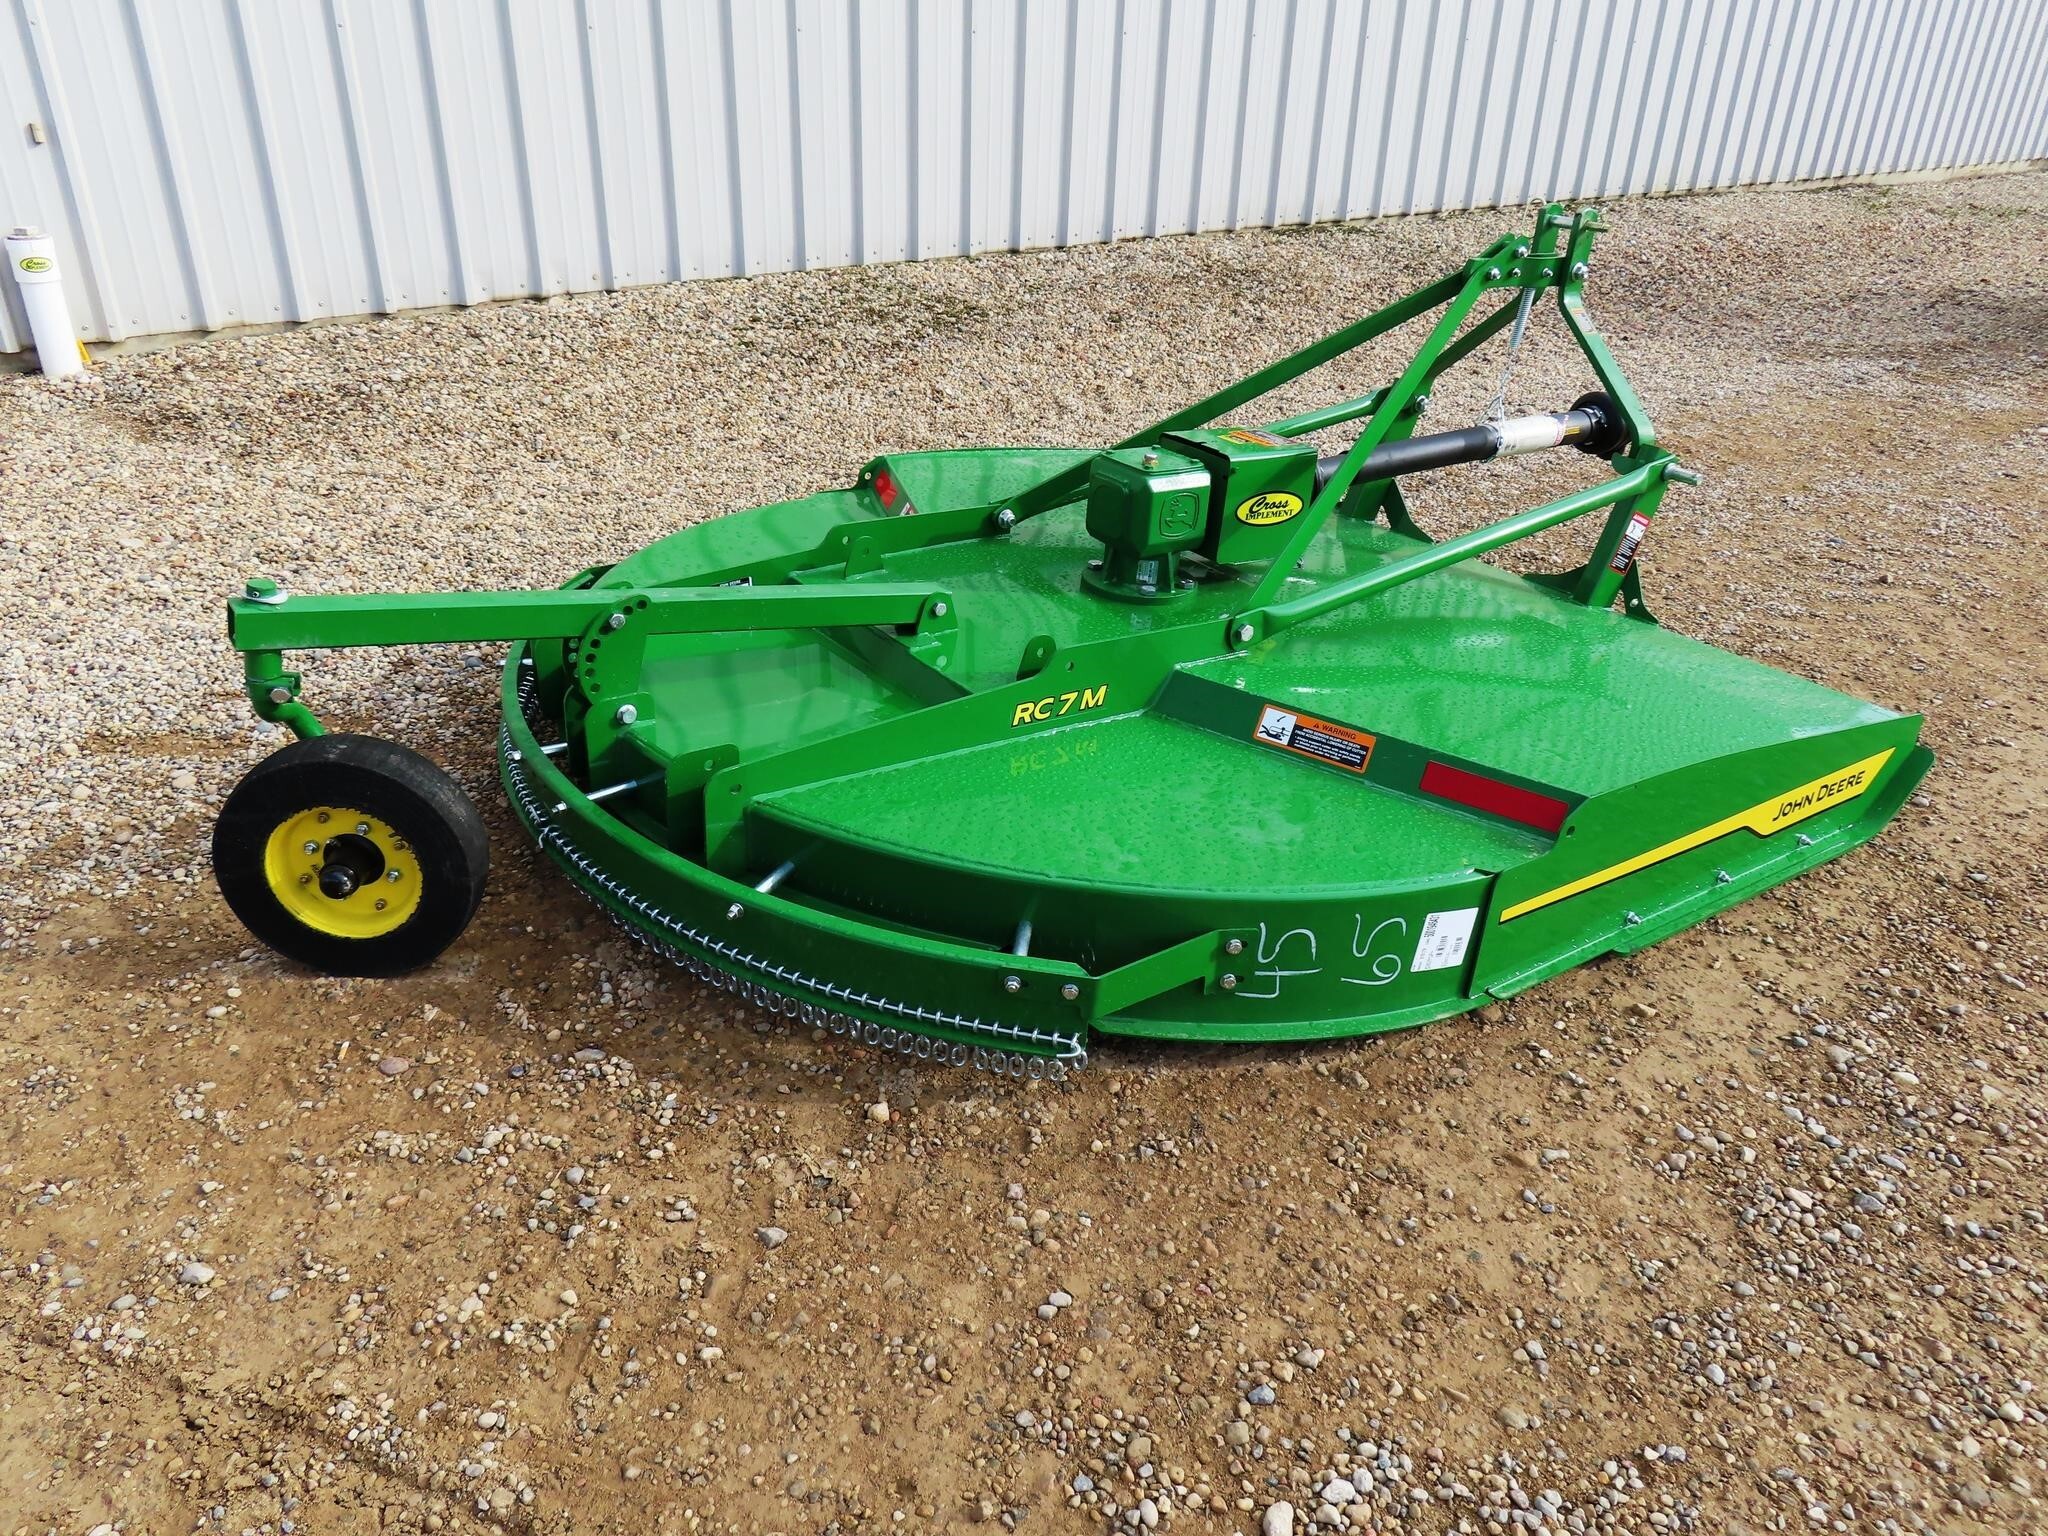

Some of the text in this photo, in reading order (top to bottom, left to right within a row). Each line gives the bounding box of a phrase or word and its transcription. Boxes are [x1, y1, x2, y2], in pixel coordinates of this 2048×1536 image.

[1245, 509, 1294, 520] IMPLEMENT
[1248, 496, 1290, 514] Cross
[1322, 724, 1357, 740] WARNING
[1772, 770, 1866, 822] JOHN DEERE
[1234, 922, 1323, 998] 45
[1340, 913, 1407, 986] 65
